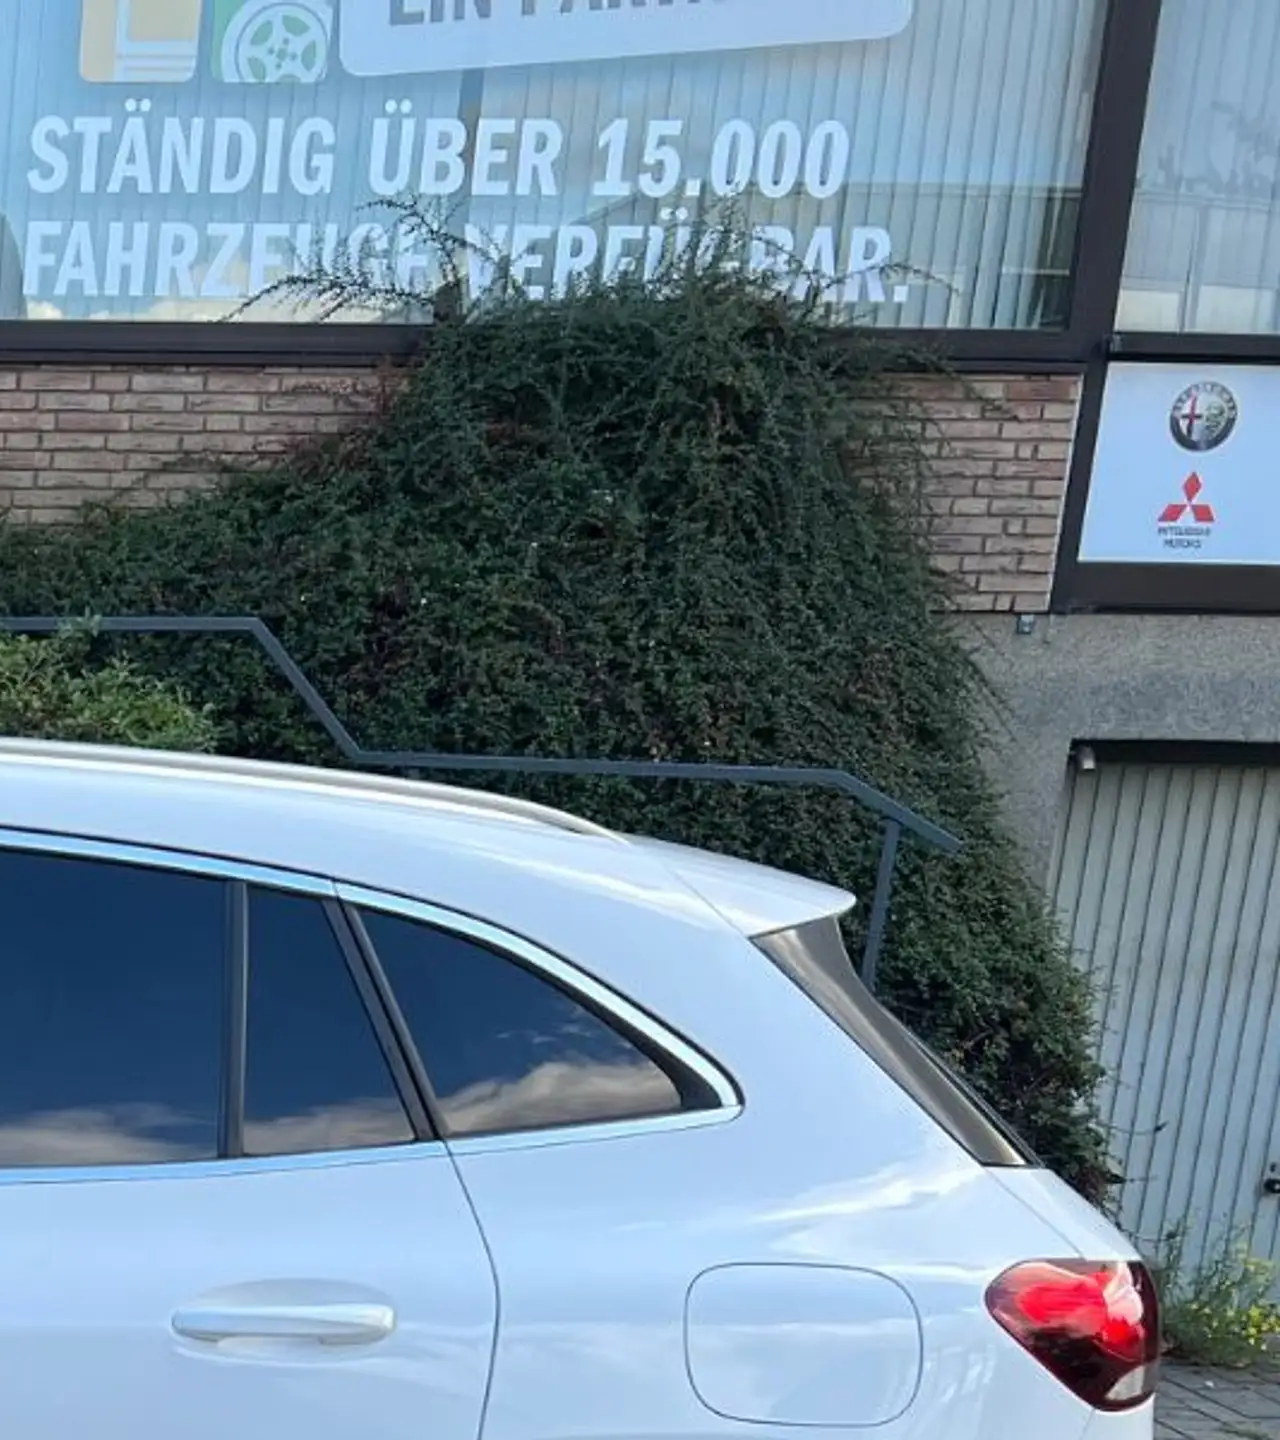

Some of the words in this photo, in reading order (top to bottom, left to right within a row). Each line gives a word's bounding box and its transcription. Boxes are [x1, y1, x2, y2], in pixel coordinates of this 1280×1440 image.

[26, 98, 335, 195] STÄNDIG
[368, 99, 563, 196] ÜBER
[592, 117, 851, 199] 15.000
[22, 219, 433, 298] FAHRZEUGE
